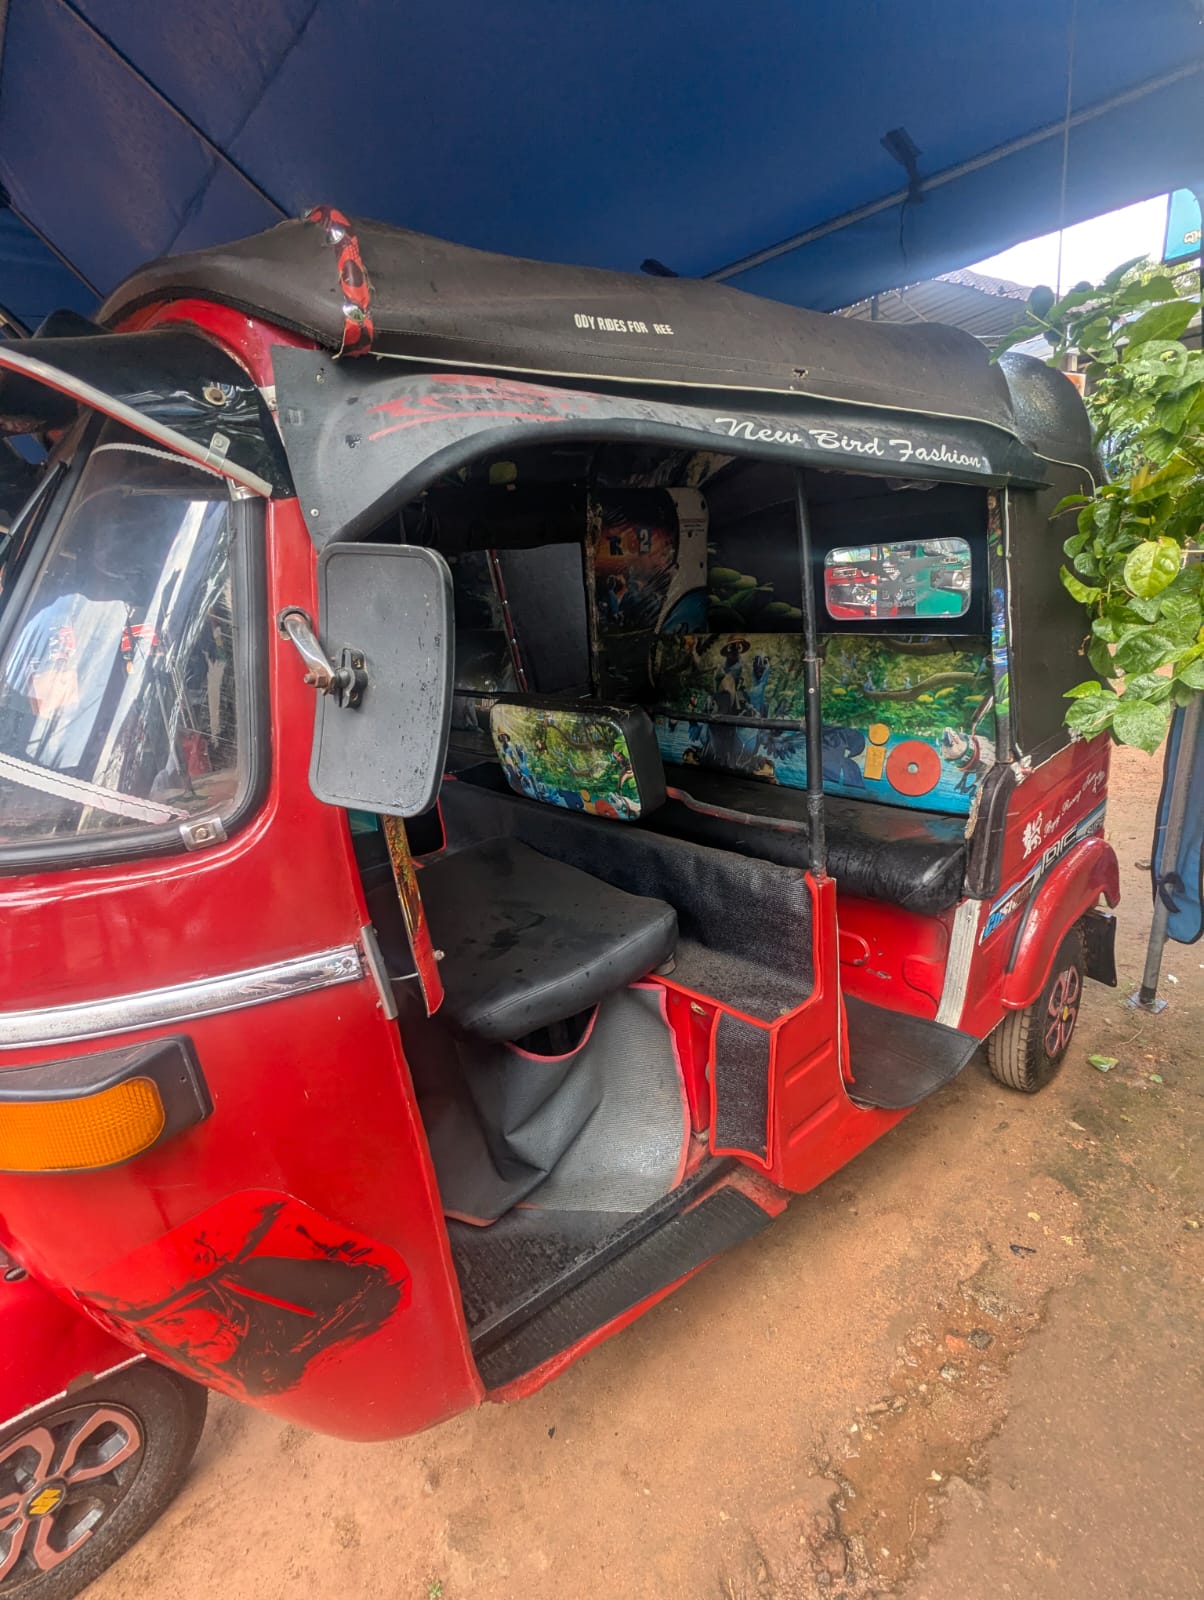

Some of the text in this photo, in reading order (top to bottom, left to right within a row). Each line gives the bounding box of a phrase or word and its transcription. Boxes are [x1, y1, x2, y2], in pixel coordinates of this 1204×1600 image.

[597, 317, 627, 333] RIDES
[627, 320, 648, 334] FOR
[714, 417, 982, 469] New Bird Fashion
